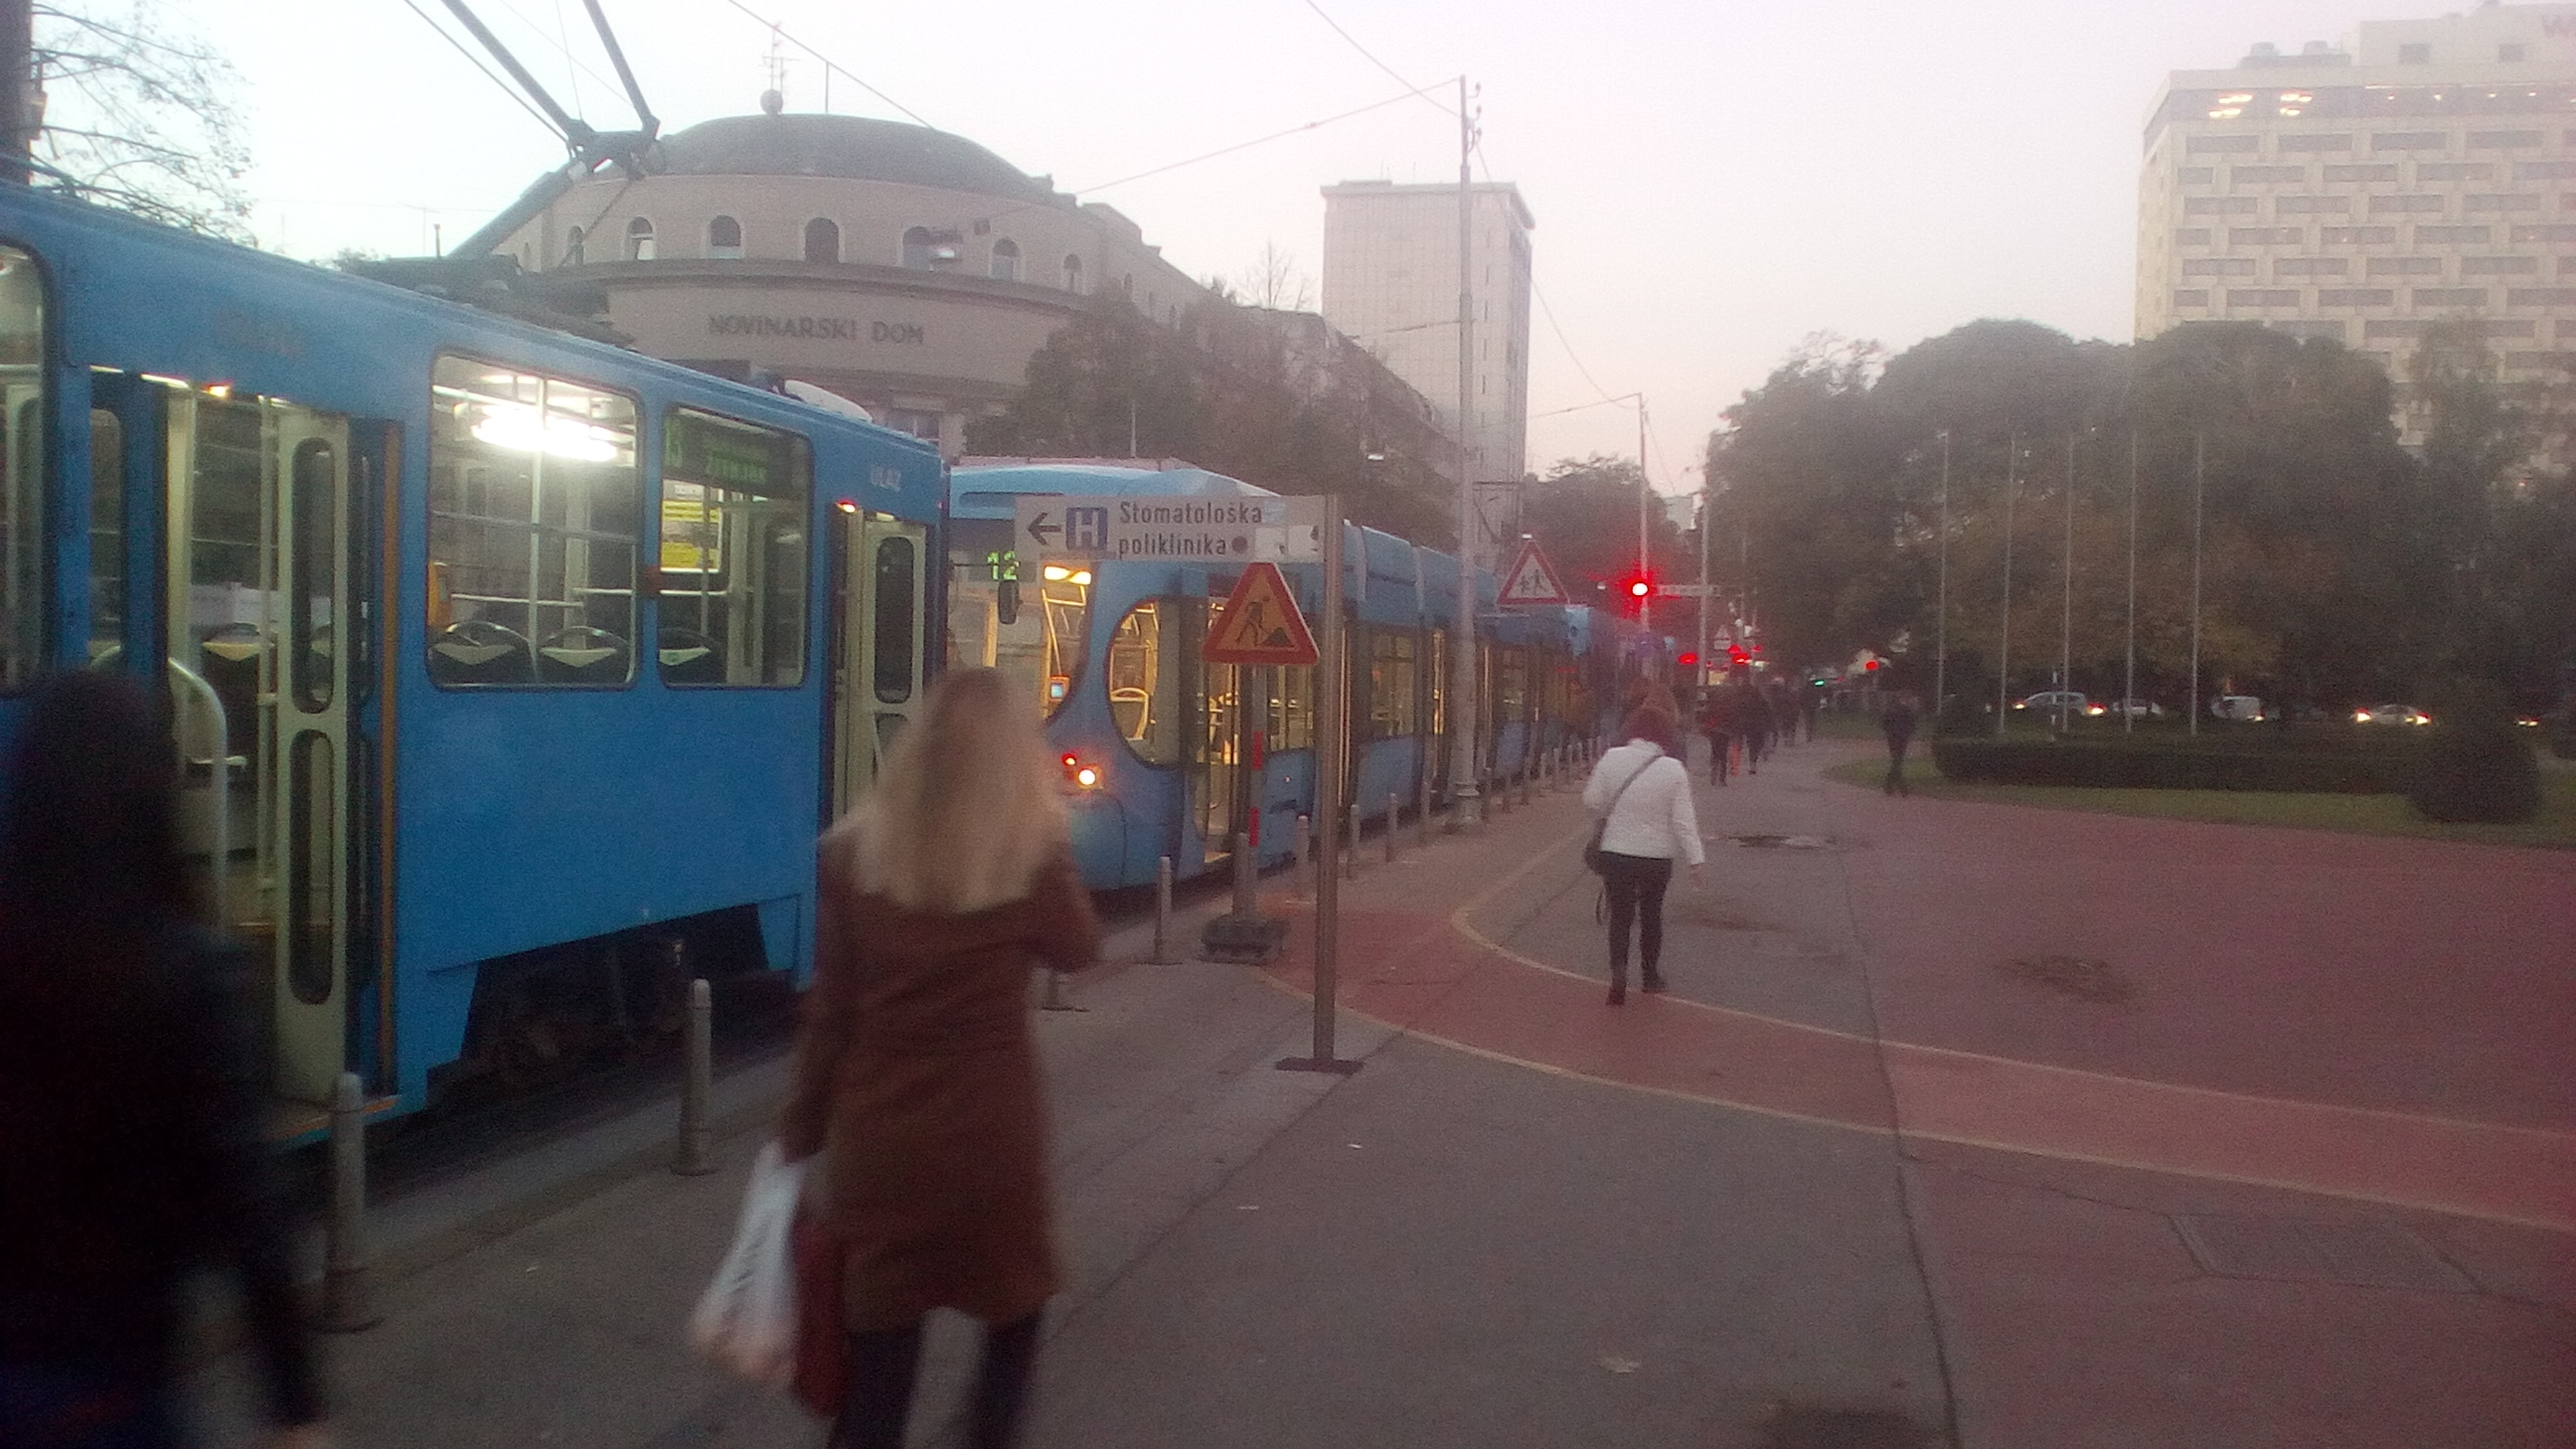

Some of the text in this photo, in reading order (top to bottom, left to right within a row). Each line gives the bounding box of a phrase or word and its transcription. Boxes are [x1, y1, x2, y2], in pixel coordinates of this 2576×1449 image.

[708, 314, 924, 344] NOVINARSKI DOM
[1119, 502, 1262, 525] Stomatološka
[1118, 533, 1227, 559] poliklinika
[987, 550, 1020, 581] 12
